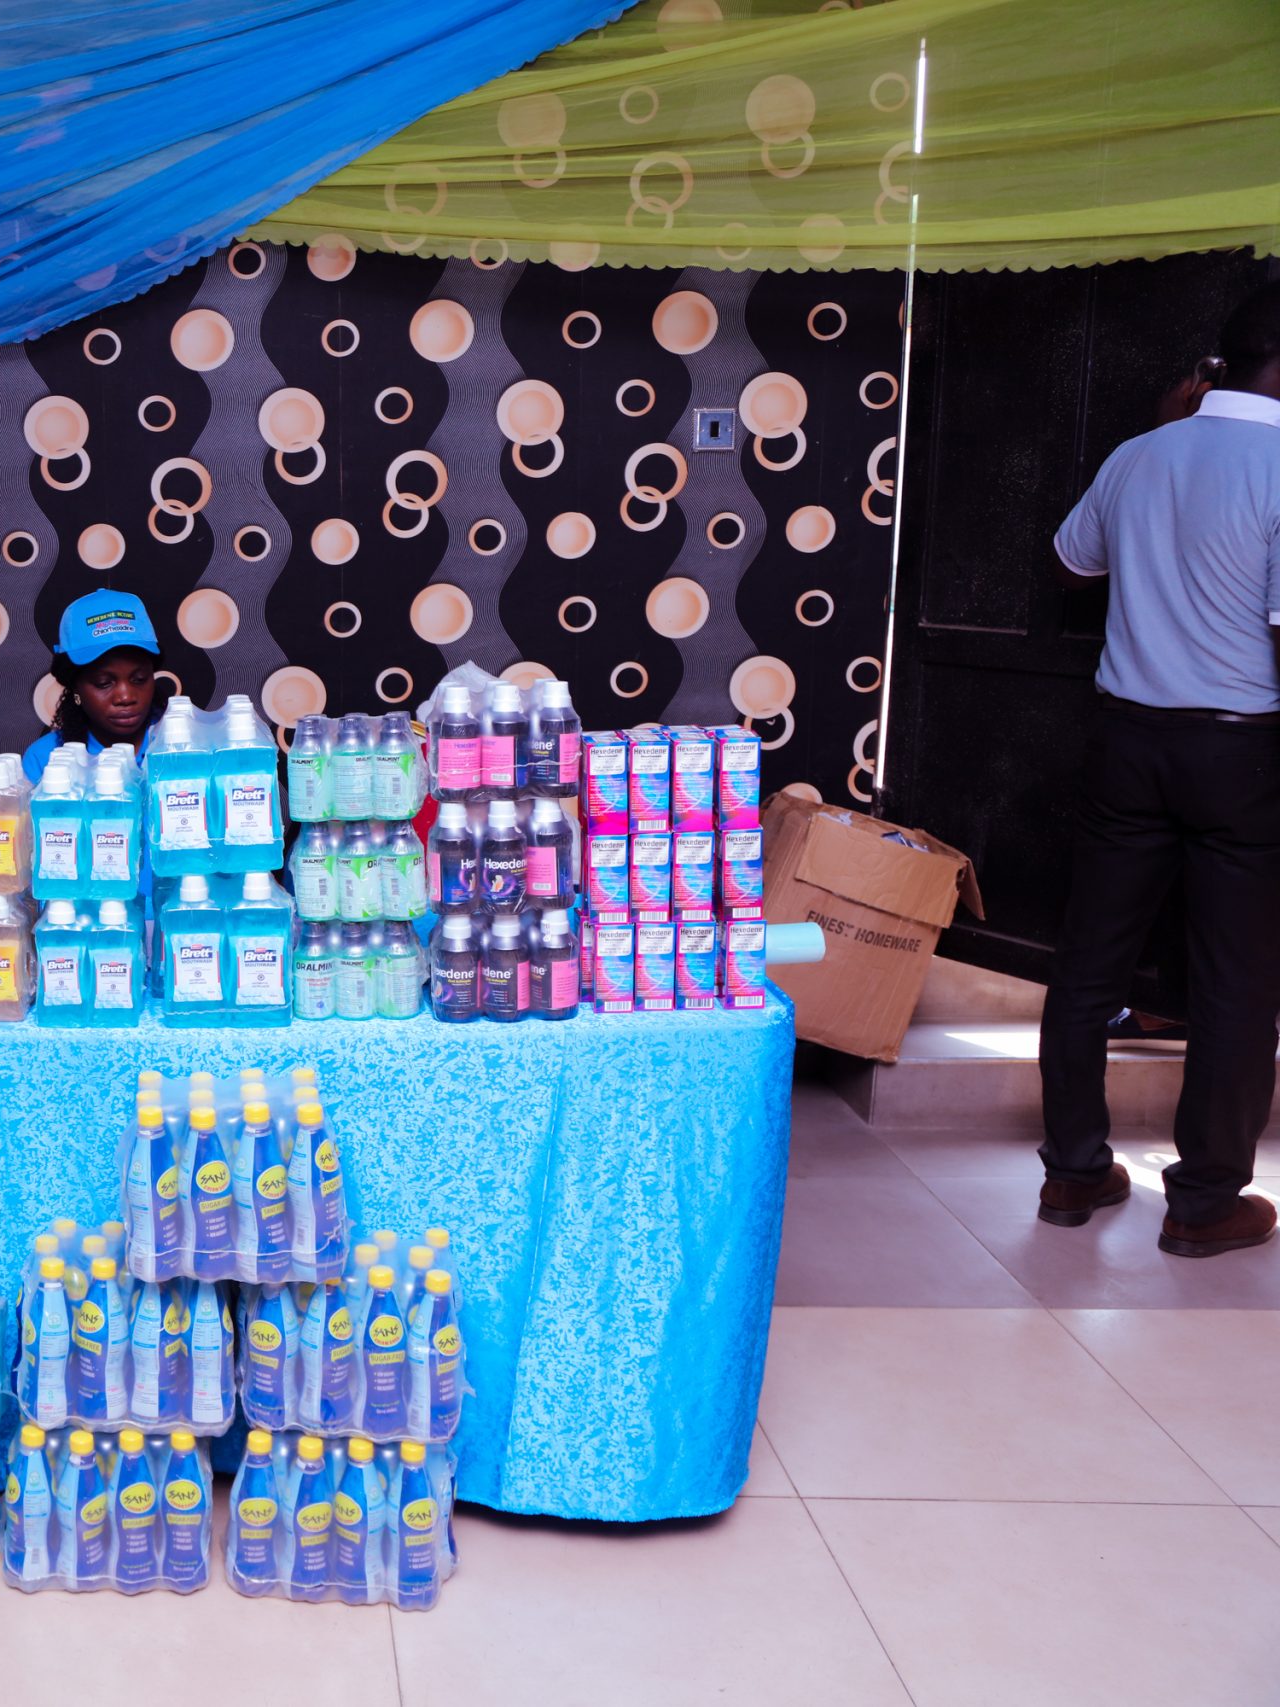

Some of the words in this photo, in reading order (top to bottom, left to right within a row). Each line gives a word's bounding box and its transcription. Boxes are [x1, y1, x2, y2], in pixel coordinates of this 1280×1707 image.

[167, 795, 199, 805] Brett
[233, 790, 265, 800] Brett
[45, 833, 72, 843] Brett
[97, 834, 123, 844] Brett
[854, 928, 922, 953] HOMEWARE
[180, 947, 212, 958] Brett
[244, 950, 276, 962] Brett
[48, 959, 73, 969] Brett
[100, 963, 127, 973] Brett
[374, 1326, 399, 1337] SANS
[169, 1490, 196, 1500] SANS
[243, 1506, 273, 1518] SANS
